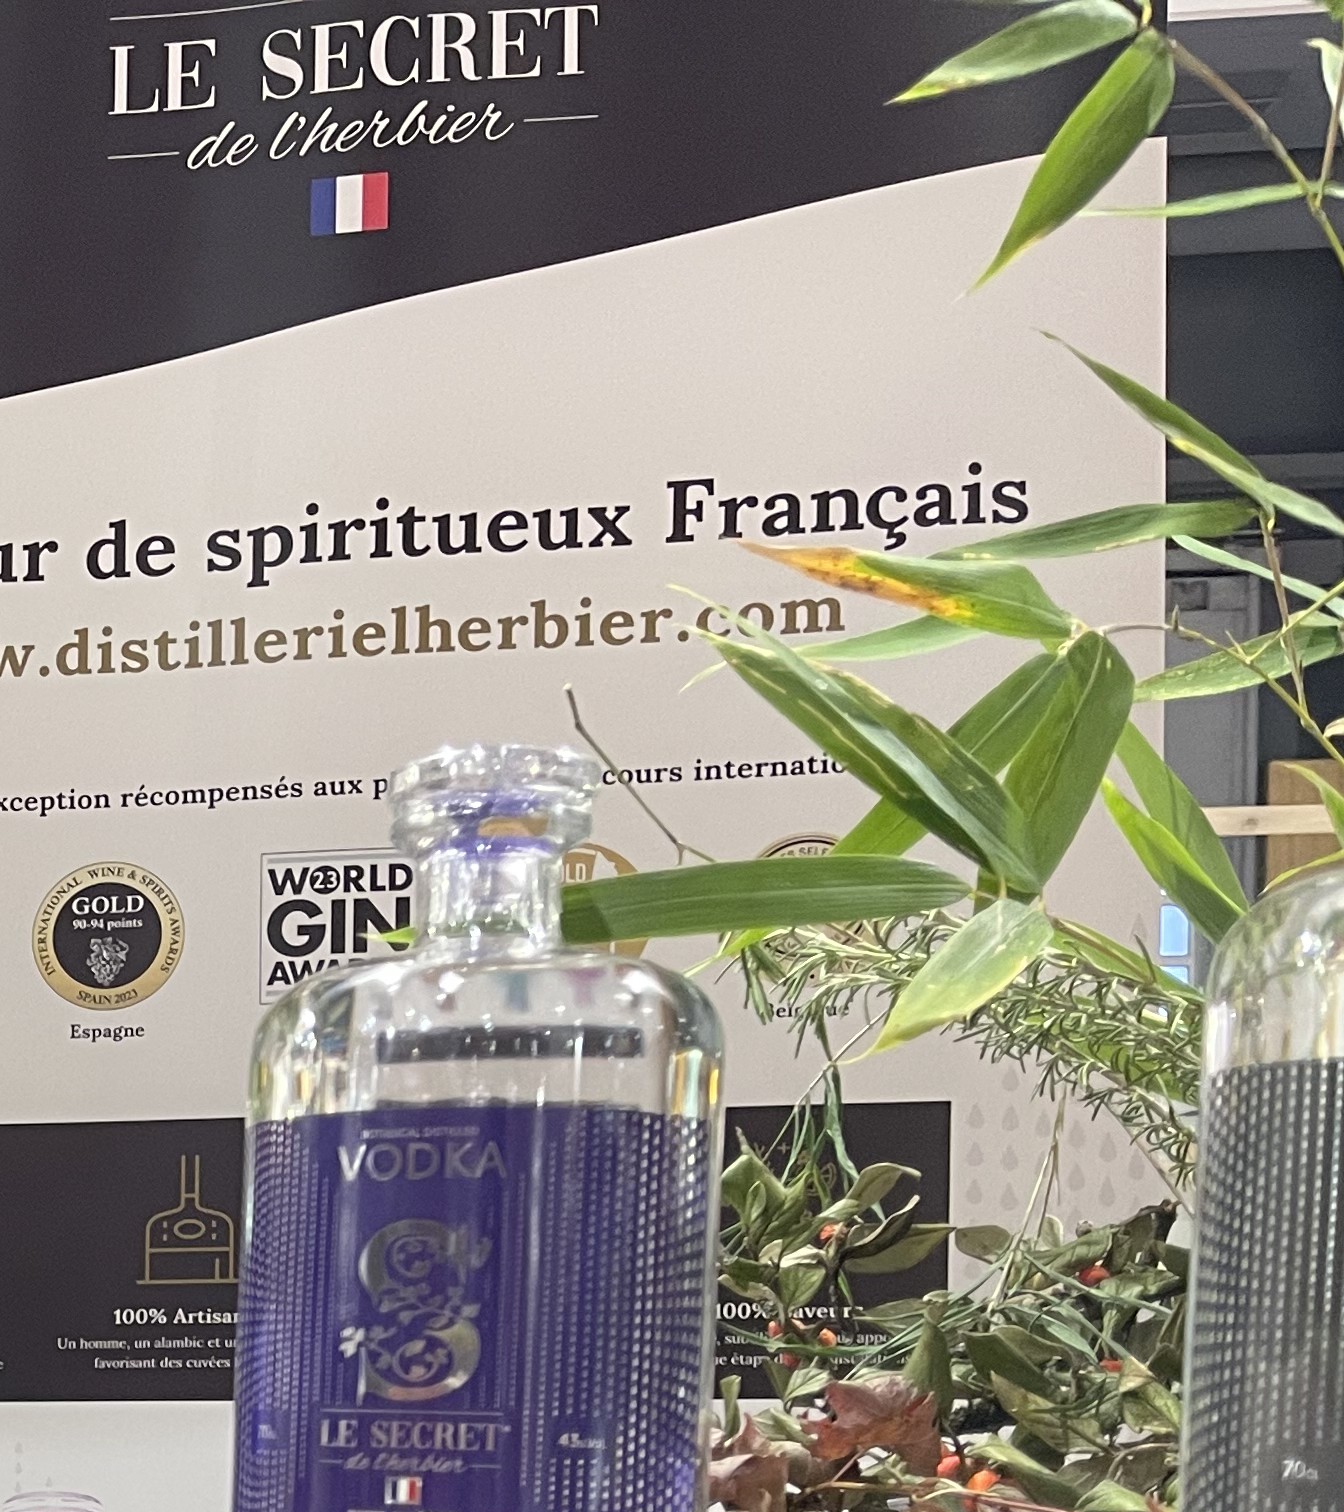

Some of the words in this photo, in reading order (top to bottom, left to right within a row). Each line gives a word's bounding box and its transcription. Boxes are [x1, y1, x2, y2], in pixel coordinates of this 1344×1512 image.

[108, 38, 216, 116] LE
[262, 4, 600, 102] SECRET
[186, 121, 258, 170] de
[86, 519, 177, 581] de
[206, 497, 633, 587] spiritueux
[665, 462, 1029, 551] Français
[120, 776, 304, 808] récompensés
[313, 777, 364, 798] aux
[71, 894, 145, 916] GOLD
[37, 876, 83, 977] INTERNATIONAL
[87, 866, 125, 880] WINE
[139, 875, 177, 915] SPIRITS
[160, 917, 181, 974] AWARDS
[106, 917, 144, 931] points
[267, 896, 412, 958] GIN
[70, 1024, 145, 1043] Espagne
[337, 1140, 508, 1182] VODKA
[113, 1308, 168, 1326] 100%
[57, 1337, 77, 1350] Un
[79, 1337, 131, 1352] homme,
[134, 1337, 151, 1349] un
[153, 1336, 204, 1349] alambic
[207, 1337, 221, 1349] et
[94, 1356, 156, 1370] favorisant
[159, 1357, 183, 1370] des
[185, 1355, 231, 1370] cuvées
[320, 1419, 358, 1448] LE
[369, 1419, 506, 1451] SECRET
